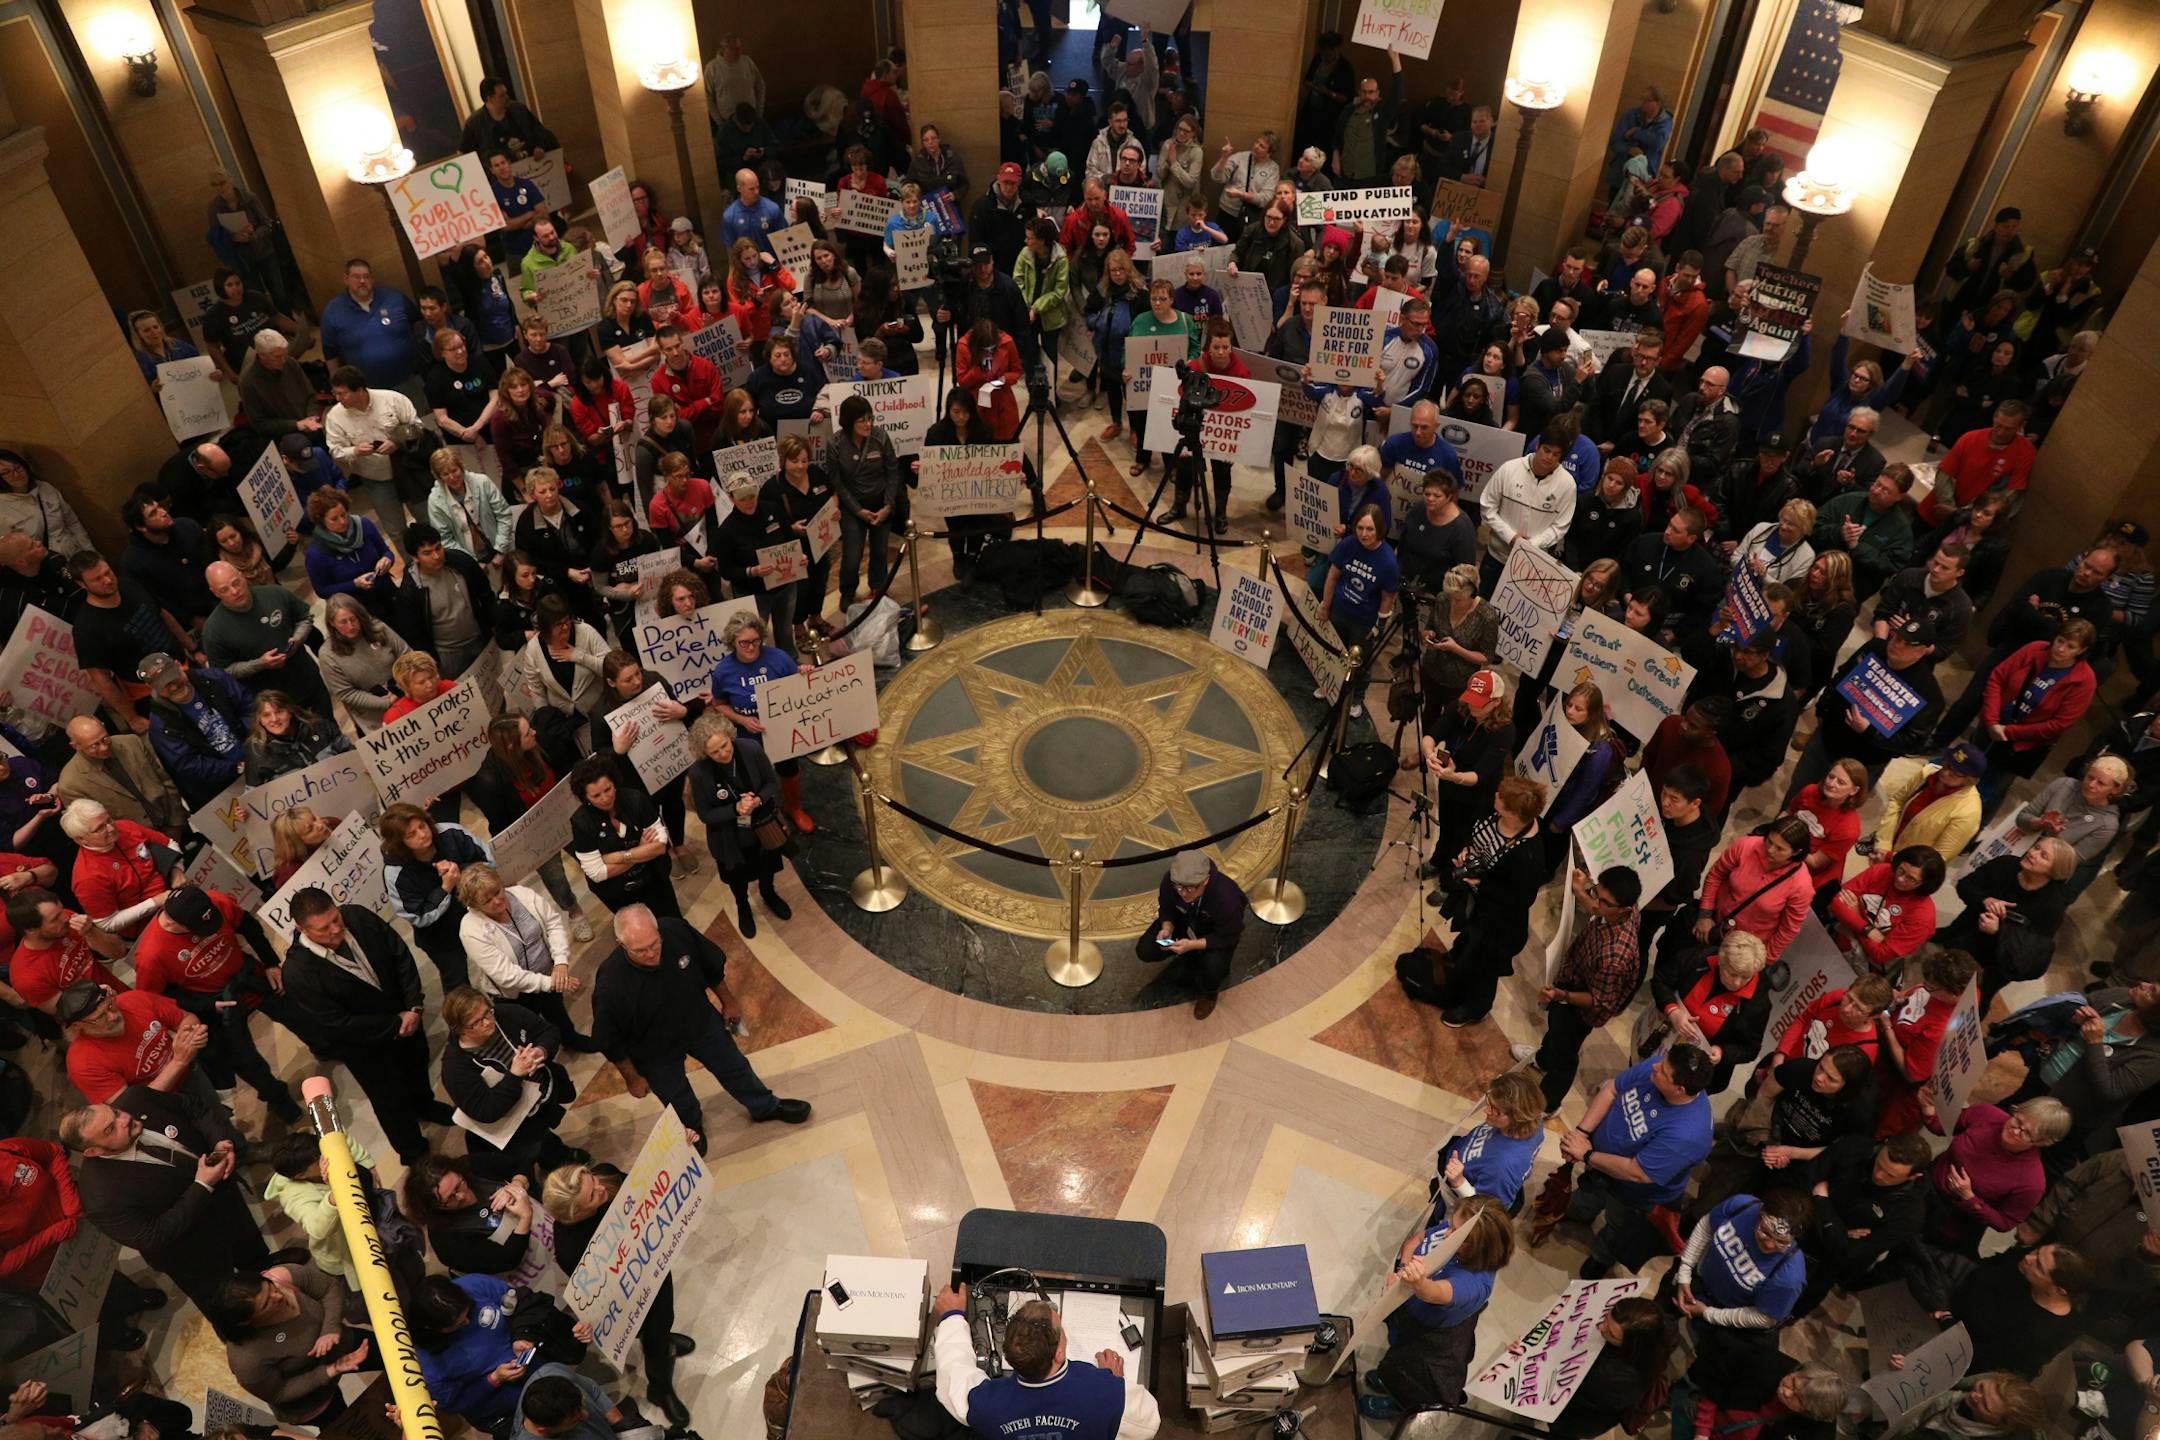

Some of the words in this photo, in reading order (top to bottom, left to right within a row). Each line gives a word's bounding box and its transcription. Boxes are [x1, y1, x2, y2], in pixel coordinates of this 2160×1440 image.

[1360, 14, 1396, 37] HURT
[1399, 23, 1431, 49] KIDS
[1114, 189, 1138, 203] DON'T
[1138, 191, 1159, 204] SINK
[1128, 202, 1159, 216] SCHOOL
[1322, 190, 1358, 203] FUND
[1365, 188, 1411, 200] PUBLIC
[410, 189, 485, 234] PUBLIC
[1335, 207, 1411, 220] EDUCATION
[414, 202, 503, 254] SCHOOLS!
[1750, 275, 1807, 305] Making
[1758, 266, 1820, 292] Teachers
[555, 304, 578, 321] TRY
[1747, 288, 1809, 316] America
[1322, 325, 1374, 341] SCHOOLS
[1329, 311, 1371, 326] PUBLIC
[1750, 316, 1799, 342] Again!
[693, 323, 727, 346] PUBLIC
[693, 334, 734, 358] SCHOOLS
[1154, 339, 1158, 351] I
[1323, 339, 1345, 353] ARE
[1347, 341, 1369, 354] FOR
[719, 349, 736, 363] FOR
[1144, 352, 1169, 365] LOVE
[1316, 351, 1374, 369] EVERYONE
[166, 367, 203, 383] Schools
[853, 379, 908, 398] SUPPORT
[874, 395, 926, 413] Childhood
[722, 459, 749, 474] SCHOOL
[939, 444, 1008, 460] INVESTMENT
[1404, 459, 1428, 471] KIDS
[248, 455, 273, 492] PUBLIC
[923, 464, 935, 474] in
[942, 459, 1001, 483] Knowledge
[252, 466, 282, 510] SCHOOLS
[941, 480, 968, 500] BEST
[1293, 487, 1328, 512] STRONG
[1299, 476, 1320, 496] STAY
[260, 502, 276, 521] ARE
[273, 481, 287, 502] FOR
[1301, 505, 1320, 522] GOV.
[1293, 514, 1332, 539] DAYTON!
[1352, 558, 1374, 572] KIDS
[1230, 588, 1273, 619] SCHOOLS
[1238, 576, 1273, 602] PUBLIC
[1736, 574, 1761, 620] STRONG
[1739, 562, 1770, 622] TEAMSTER
[1229, 604, 1247, 623] ARE
[1248, 614, 1268, 632] FOR
[1497, 586, 1540, 629] FUND
[642, 614, 710, 647] Don't
[1221, 616, 1270, 649] EVERYONE
[1582, 624, 1622, 652] Great
[642, 637, 706, 666] Take
[1569, 640, 1618, 675] Teachers
[20, 670, 73, 706] SERVE
[671, 670, 715, 698] pport
[740, 676, 745, 687] I
[748, 674, 768, 686] am
[804, 663, 857, 690] FUND
[1643, 657, 1681, 690] Great
[1867, 657, 1920, 708] TEAMSTER
[766, 677, 864, 720] Education
[1864, 670, 1907, 709] STRONG
[366, 717, 422, 756] Which
[428, 684, 476, 726] protest
[640, 715, 651, 725] in
[797, 707, 833, 727] for
[376, 759, 393, 777] is
[394, 738, 431, 765] this
[434, 706, 472, 744] one?
[790, 718, 841, 754] ALL
[653, 764, 663, 773] in
[655, 754, 689, 786] FUTURE
[248, 764, 359, 822] Vouchers
[1606, 808, 1633, 860] FUND
[1629, 814, 1653, 866] TEST
[320, 822, 373, 877] Education
[330, 848, 374, 903] GREAT
[191, 938, 227, 974] UTSWC
[1769, 969, 1829, 1043] EDUCATORS
[1964, 1005, 1979, 1047] STAY
[141, 1031, 169, 1074] UTSWC
[1625, 1087, 1649, 1140] DCUE
[575, 1207, 628, 1298] RAIN
[623, 1197, 636, 1217] OR
[631, 1124, 681, 1195] SHINE
[609, 1240, 632, 1275] WE
[630, 1169, 672, 1240] STAND
[592, 1299, 625, 1348] FOR
[618, 1155, 704, 1300] EDUCATION
[1717, 1221, 1767, 1288] DCUE
[612, 1286, 652, 1363] #VoicesForKids
[653, 1195, 703, 1280] #EducatorVoices
[1237, 1284, 1256, 1293] IRON
[1256, 1281, 1298, 1291] MOUNTAIN
[867, 1290, 906, 1299] MOUNTAIN
[364, 1233, 388, 1269] NOT
[383, 1291, 429, 1388] SCHOOLS
[1521, 1318, 1553, 1347] ALL
[1517, 1350, 1549, 1407] FUTURE
[1549, 1349, 1589, 1407] KIDS
[1000, 1417, 1032, 1435] INTER
[1034, 1415, 1081, 1431] FACULTY
